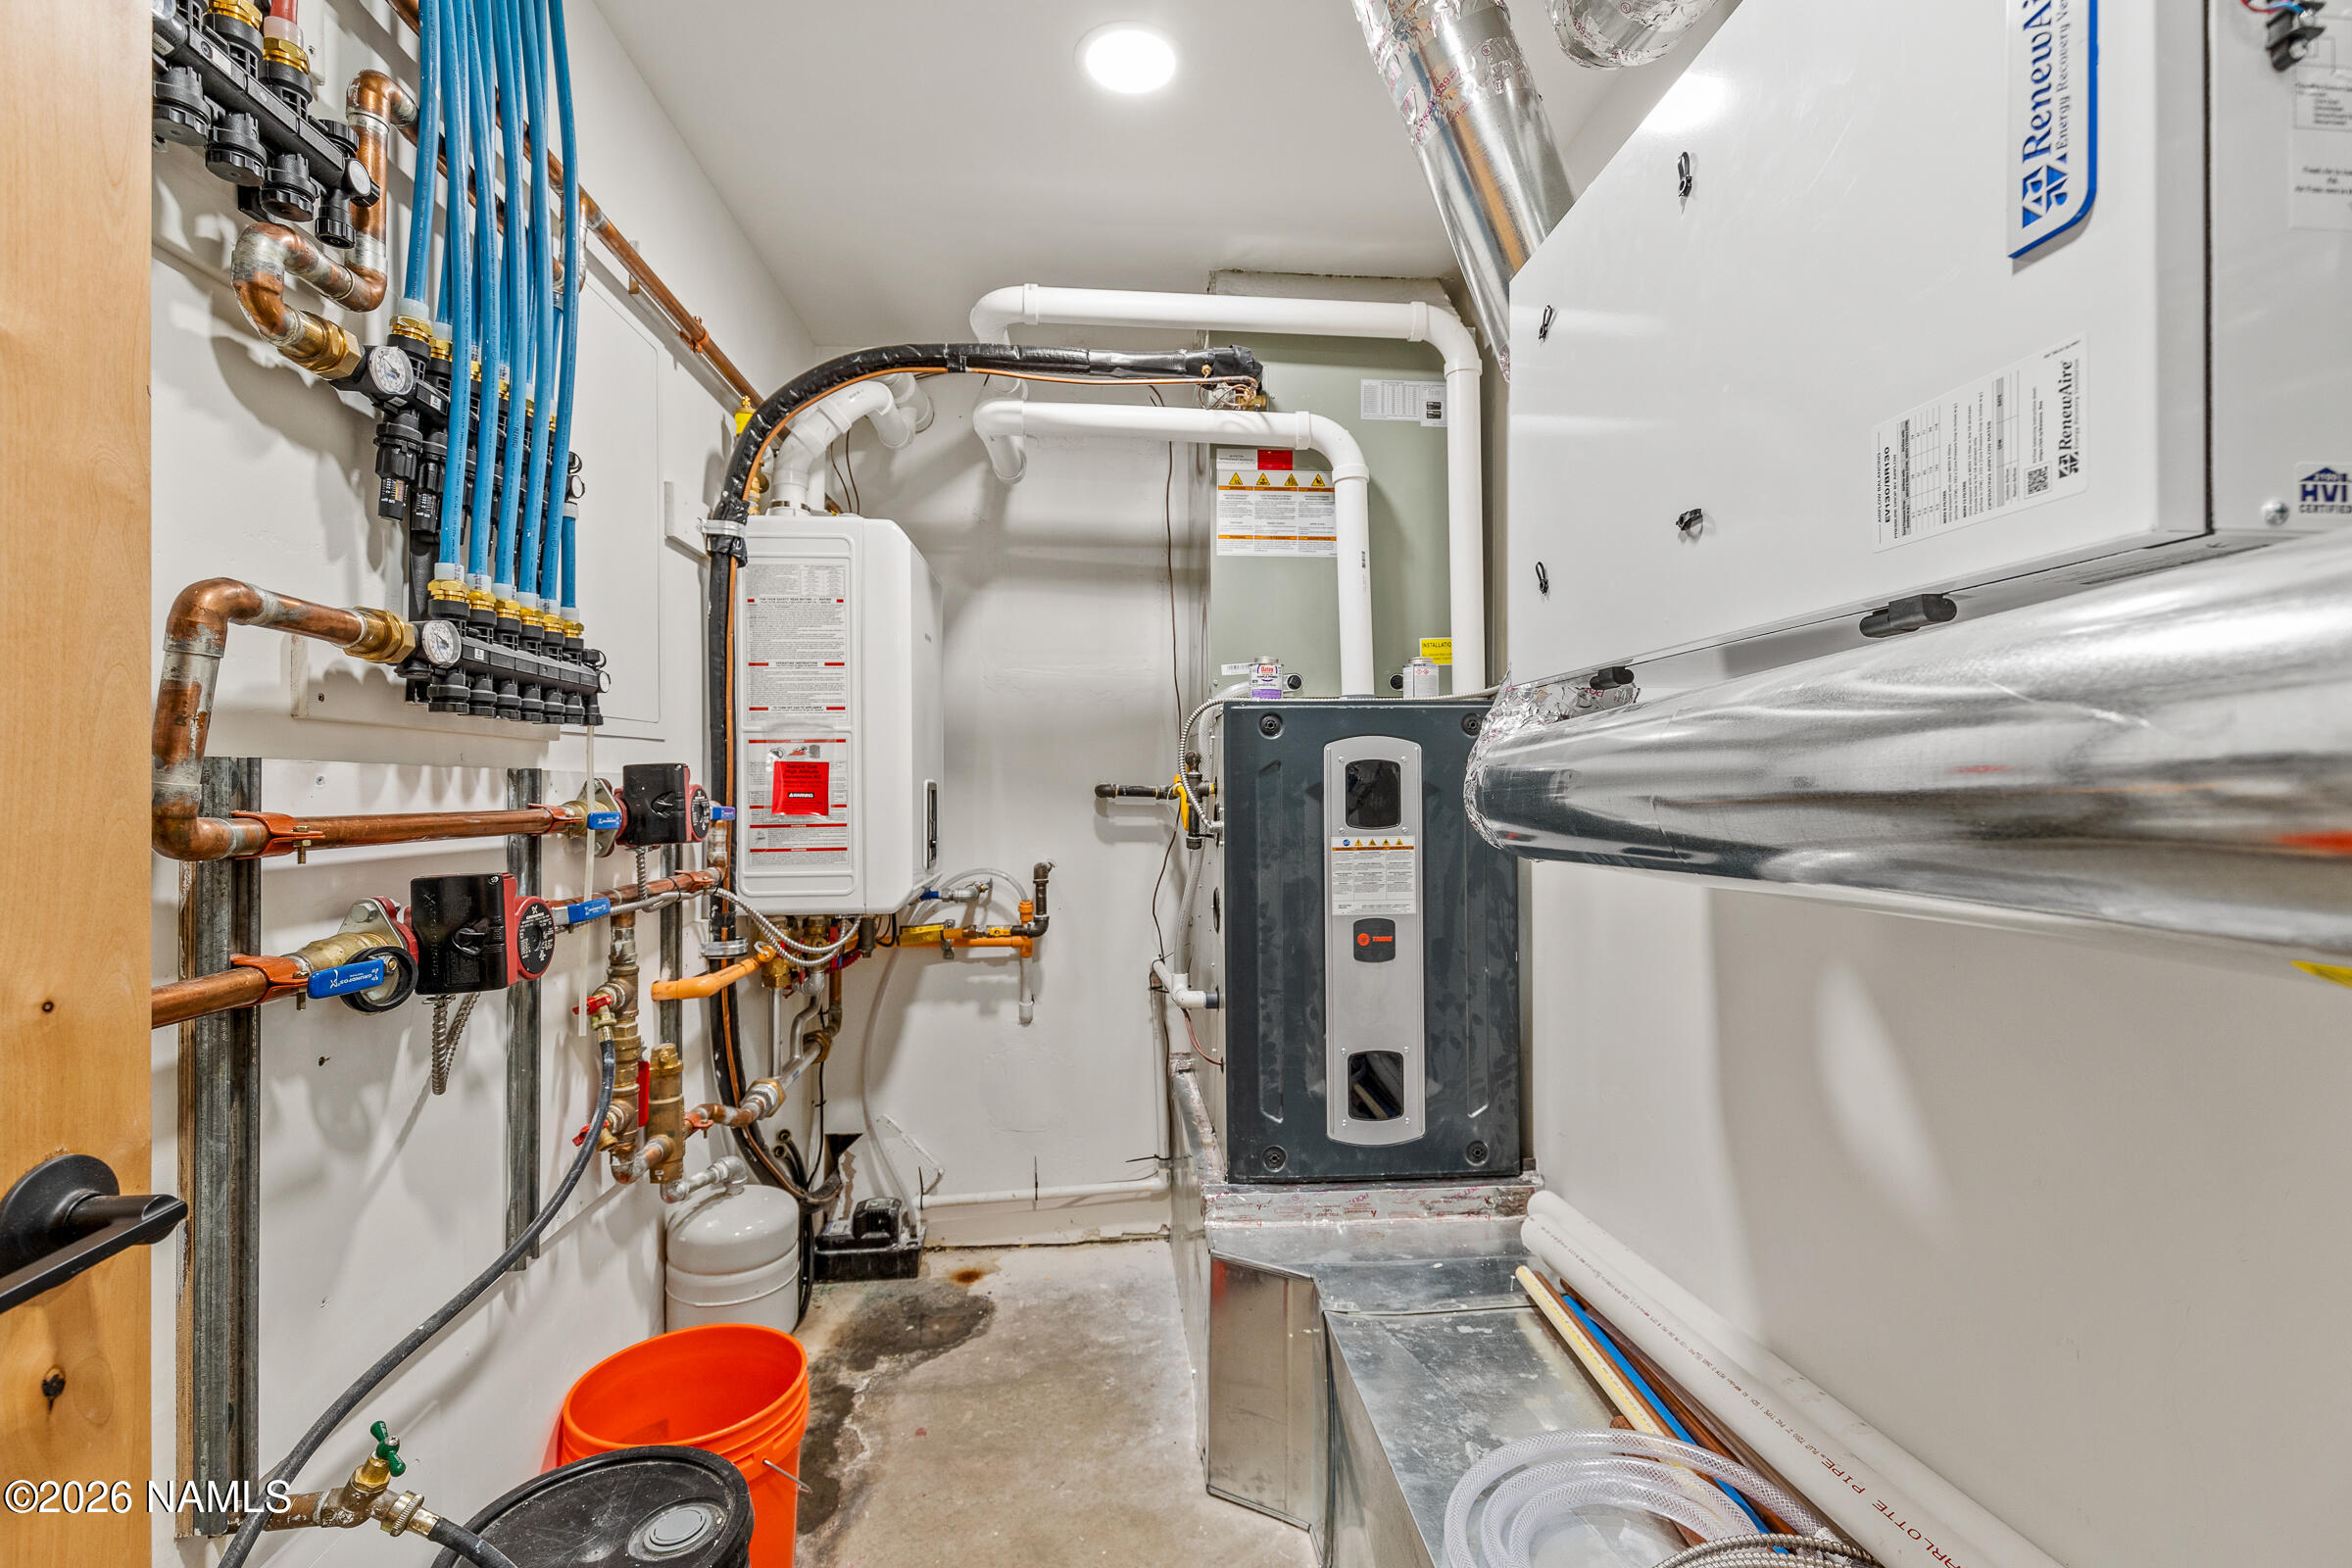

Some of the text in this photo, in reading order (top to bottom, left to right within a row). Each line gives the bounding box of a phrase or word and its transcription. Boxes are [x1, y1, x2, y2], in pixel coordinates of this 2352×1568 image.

[2056, 0, 2071, 150] Energy Recovery Ve
[2058, 361, 2072, 451] RenewAire
[2301, 484, 2348, 502] HVI
[339, 973, 372, 985] GRUNDFOS
[1820, 1457, 1866, 1495] PIPE
[1871, 1498, 1961, 1568] ARLOTTE
